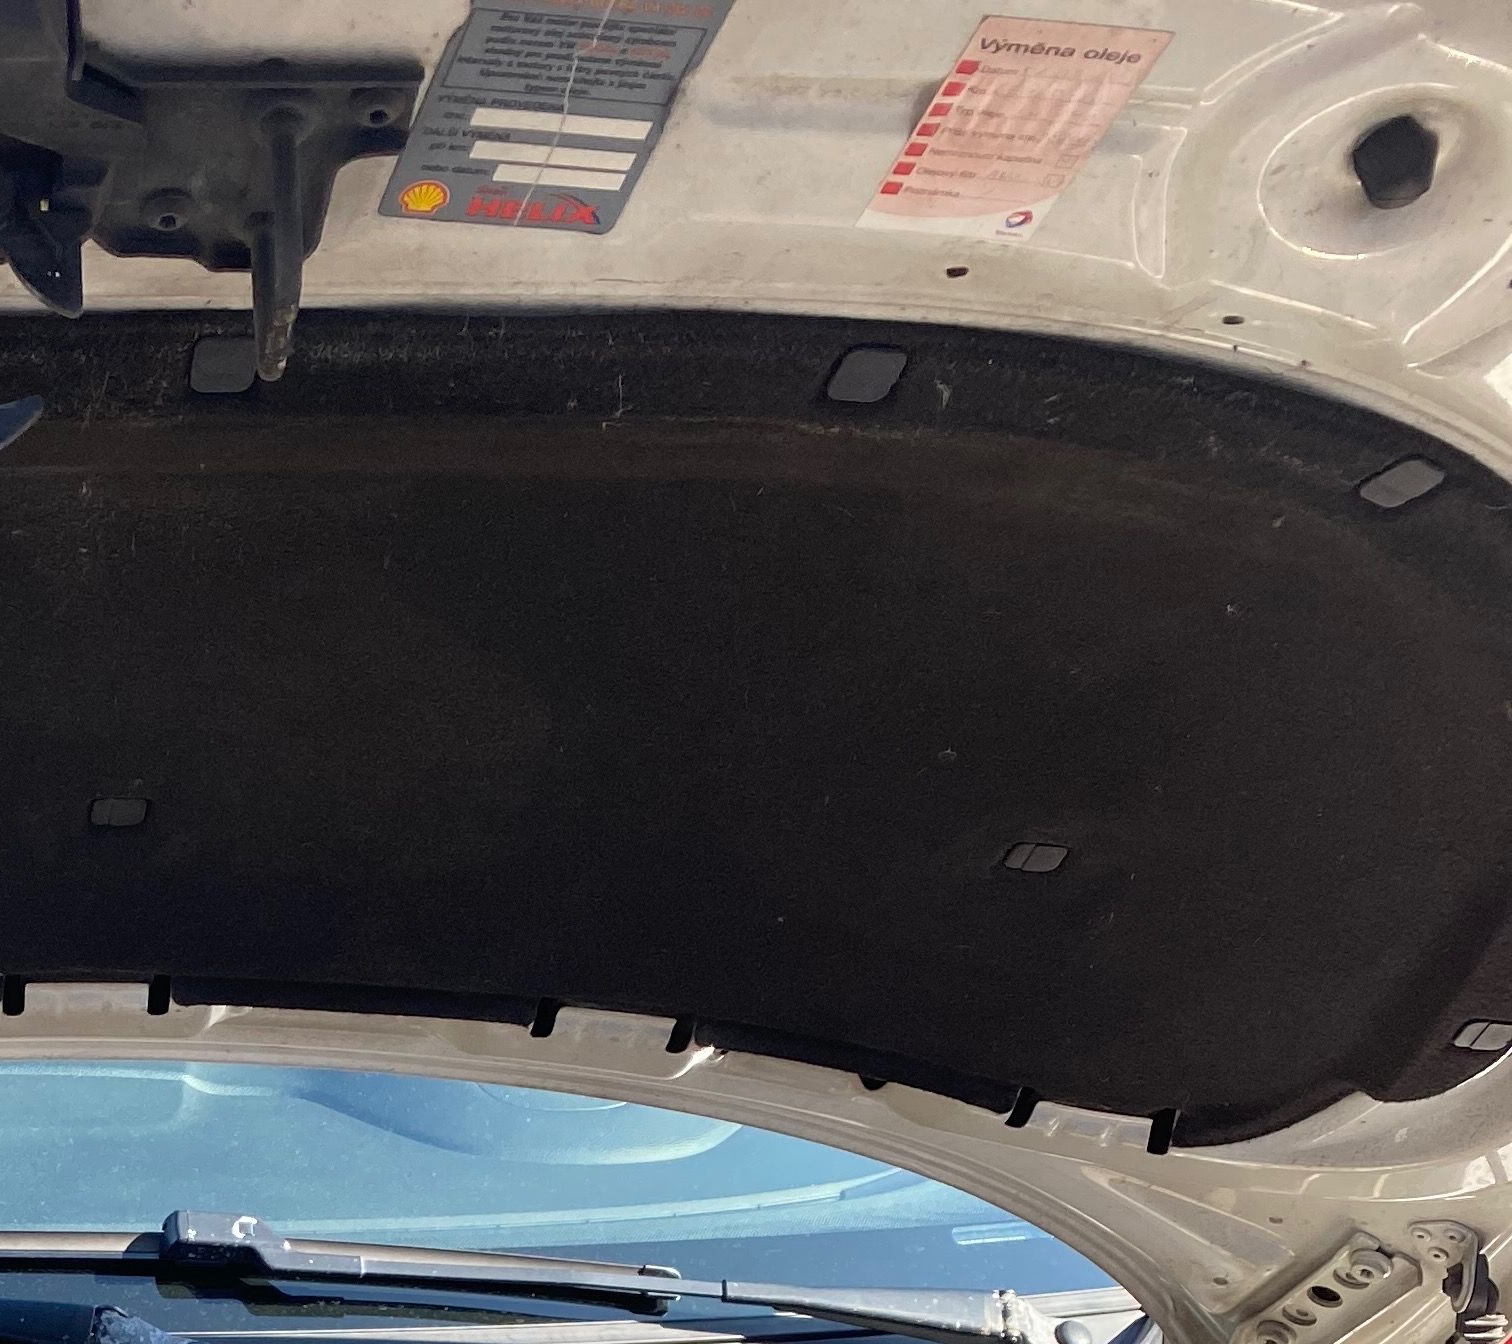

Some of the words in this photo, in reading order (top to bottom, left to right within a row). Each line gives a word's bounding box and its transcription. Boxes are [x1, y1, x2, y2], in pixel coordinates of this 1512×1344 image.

[980, 37, 1076, 60] Výměna
[1083, 48, 1142, 64] oleje
[466, 196, 598, 225] HELIX
